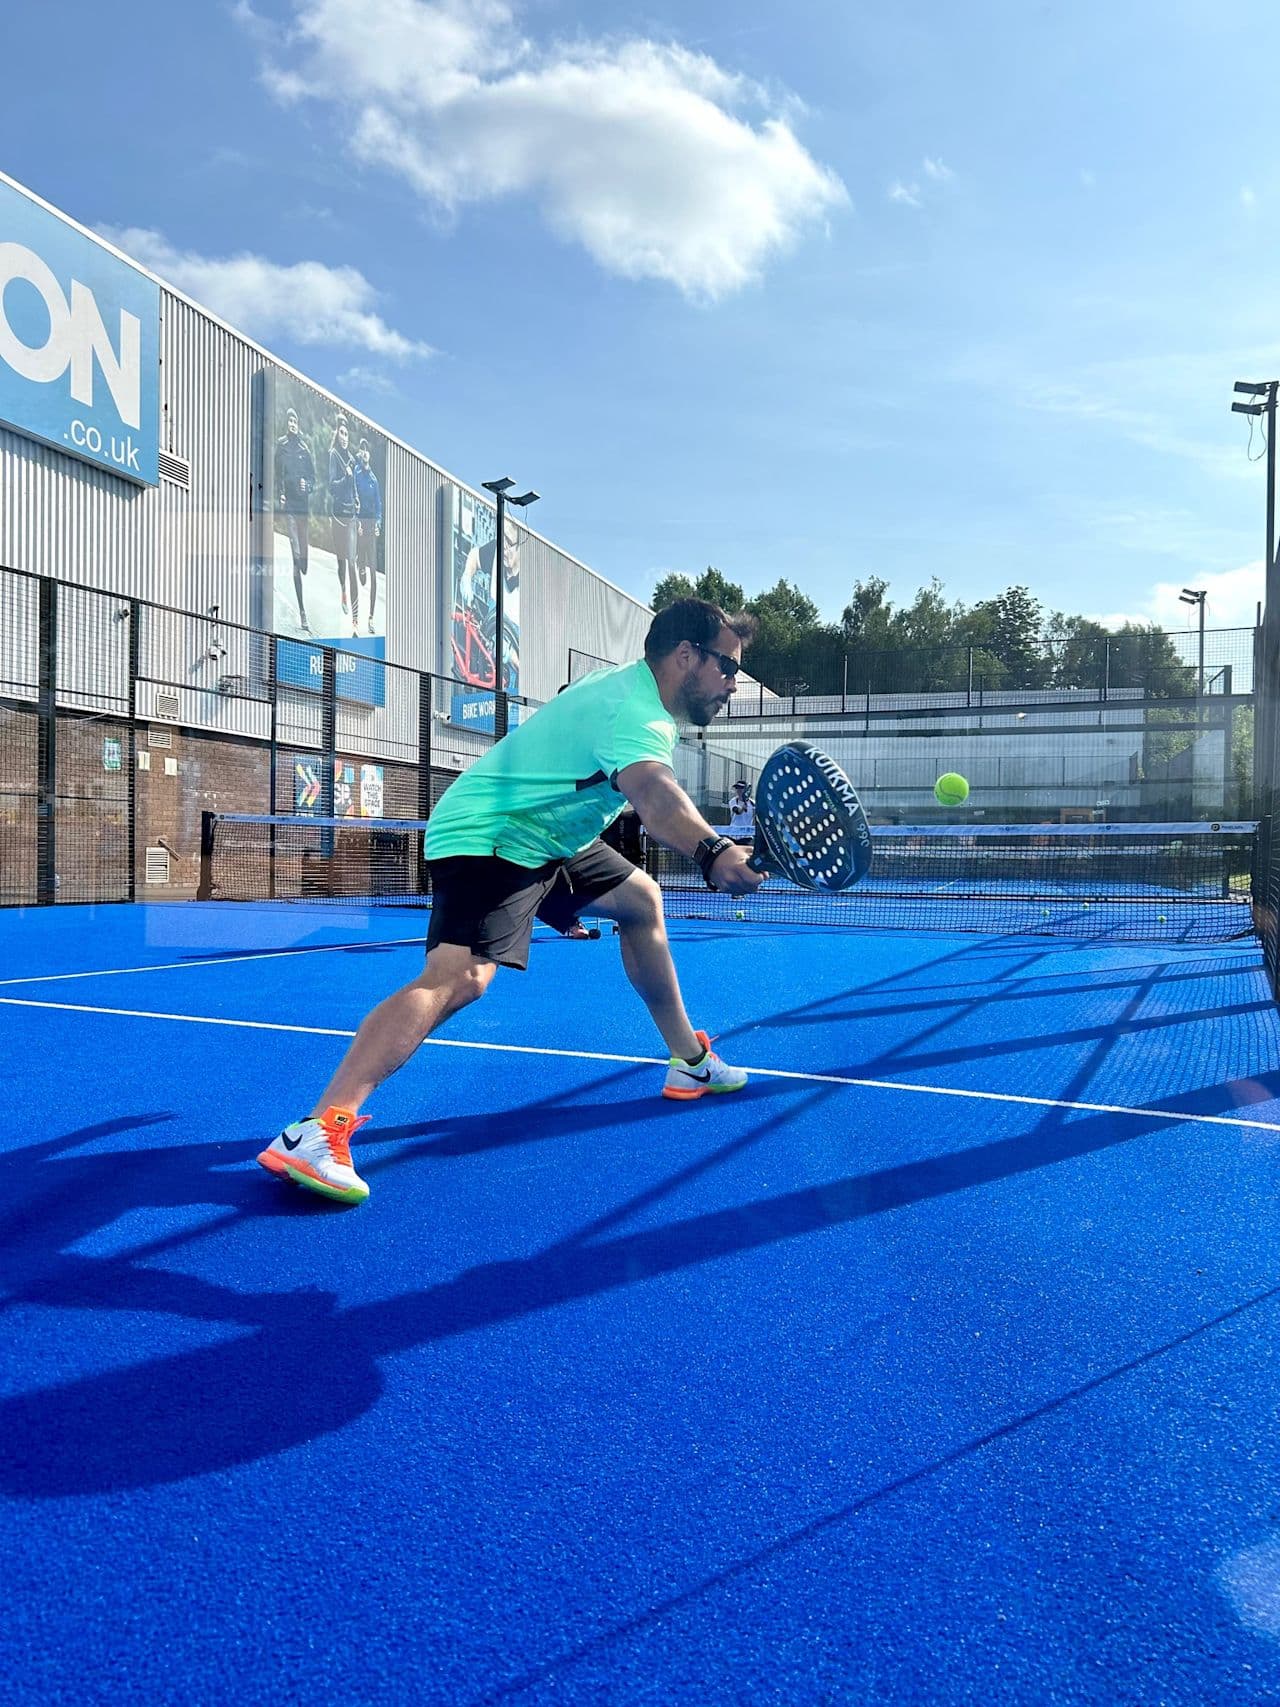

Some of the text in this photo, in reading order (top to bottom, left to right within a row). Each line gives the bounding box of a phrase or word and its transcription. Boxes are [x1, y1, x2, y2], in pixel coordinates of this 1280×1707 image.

[63, 420, 140, 471] .co.uk
[310, 654, 356, 675] RUING
[462, 703, 478, 720] BIKE
[804, 747, 859, 817] KUIKMA
